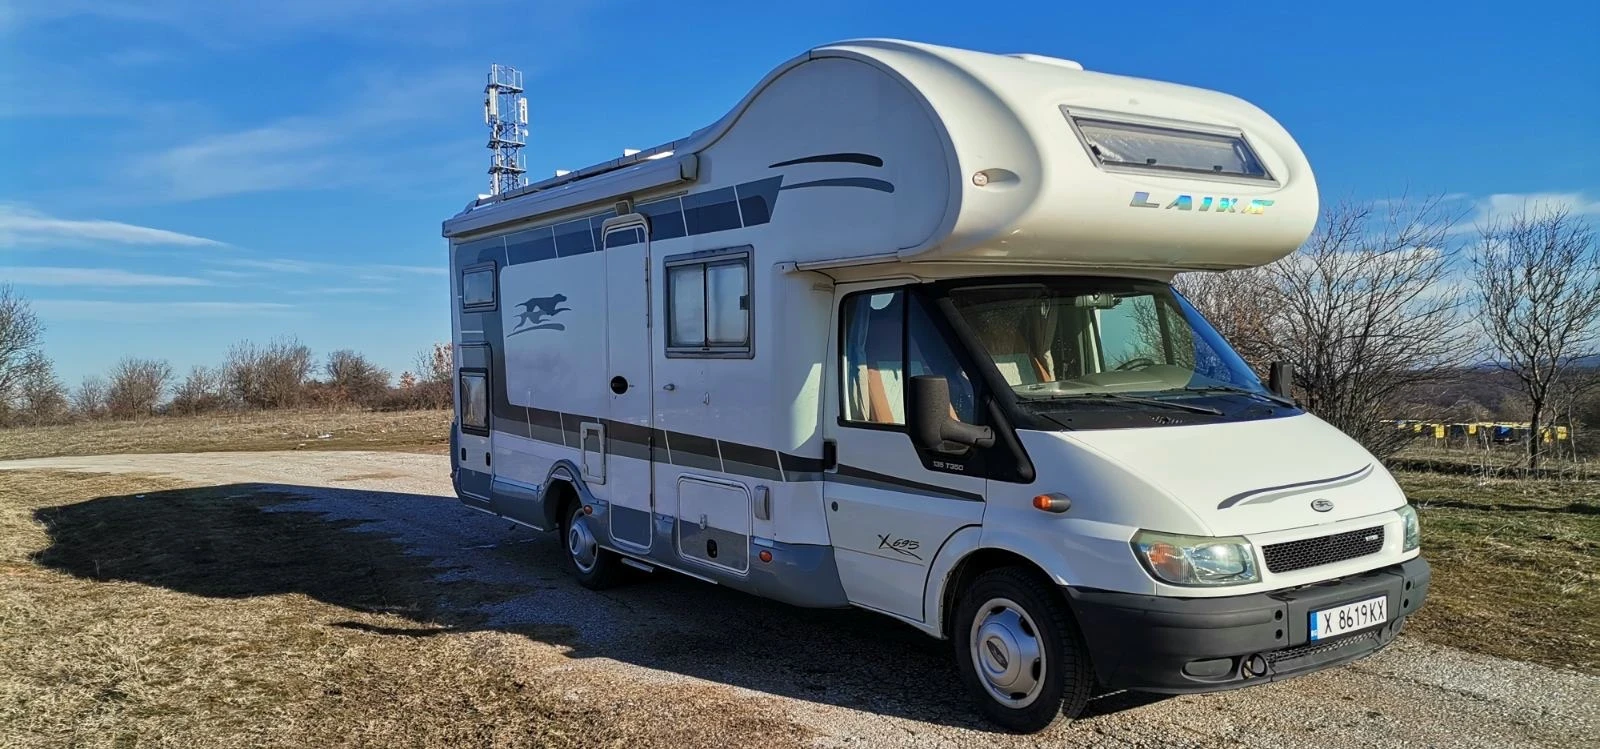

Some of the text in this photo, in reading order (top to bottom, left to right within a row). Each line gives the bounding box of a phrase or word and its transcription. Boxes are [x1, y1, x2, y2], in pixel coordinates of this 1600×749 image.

[1129, 191, 1275, 215] LAIKA
[945, 462, 964, 471] T350
[1324, 612, 1333, 634] X
